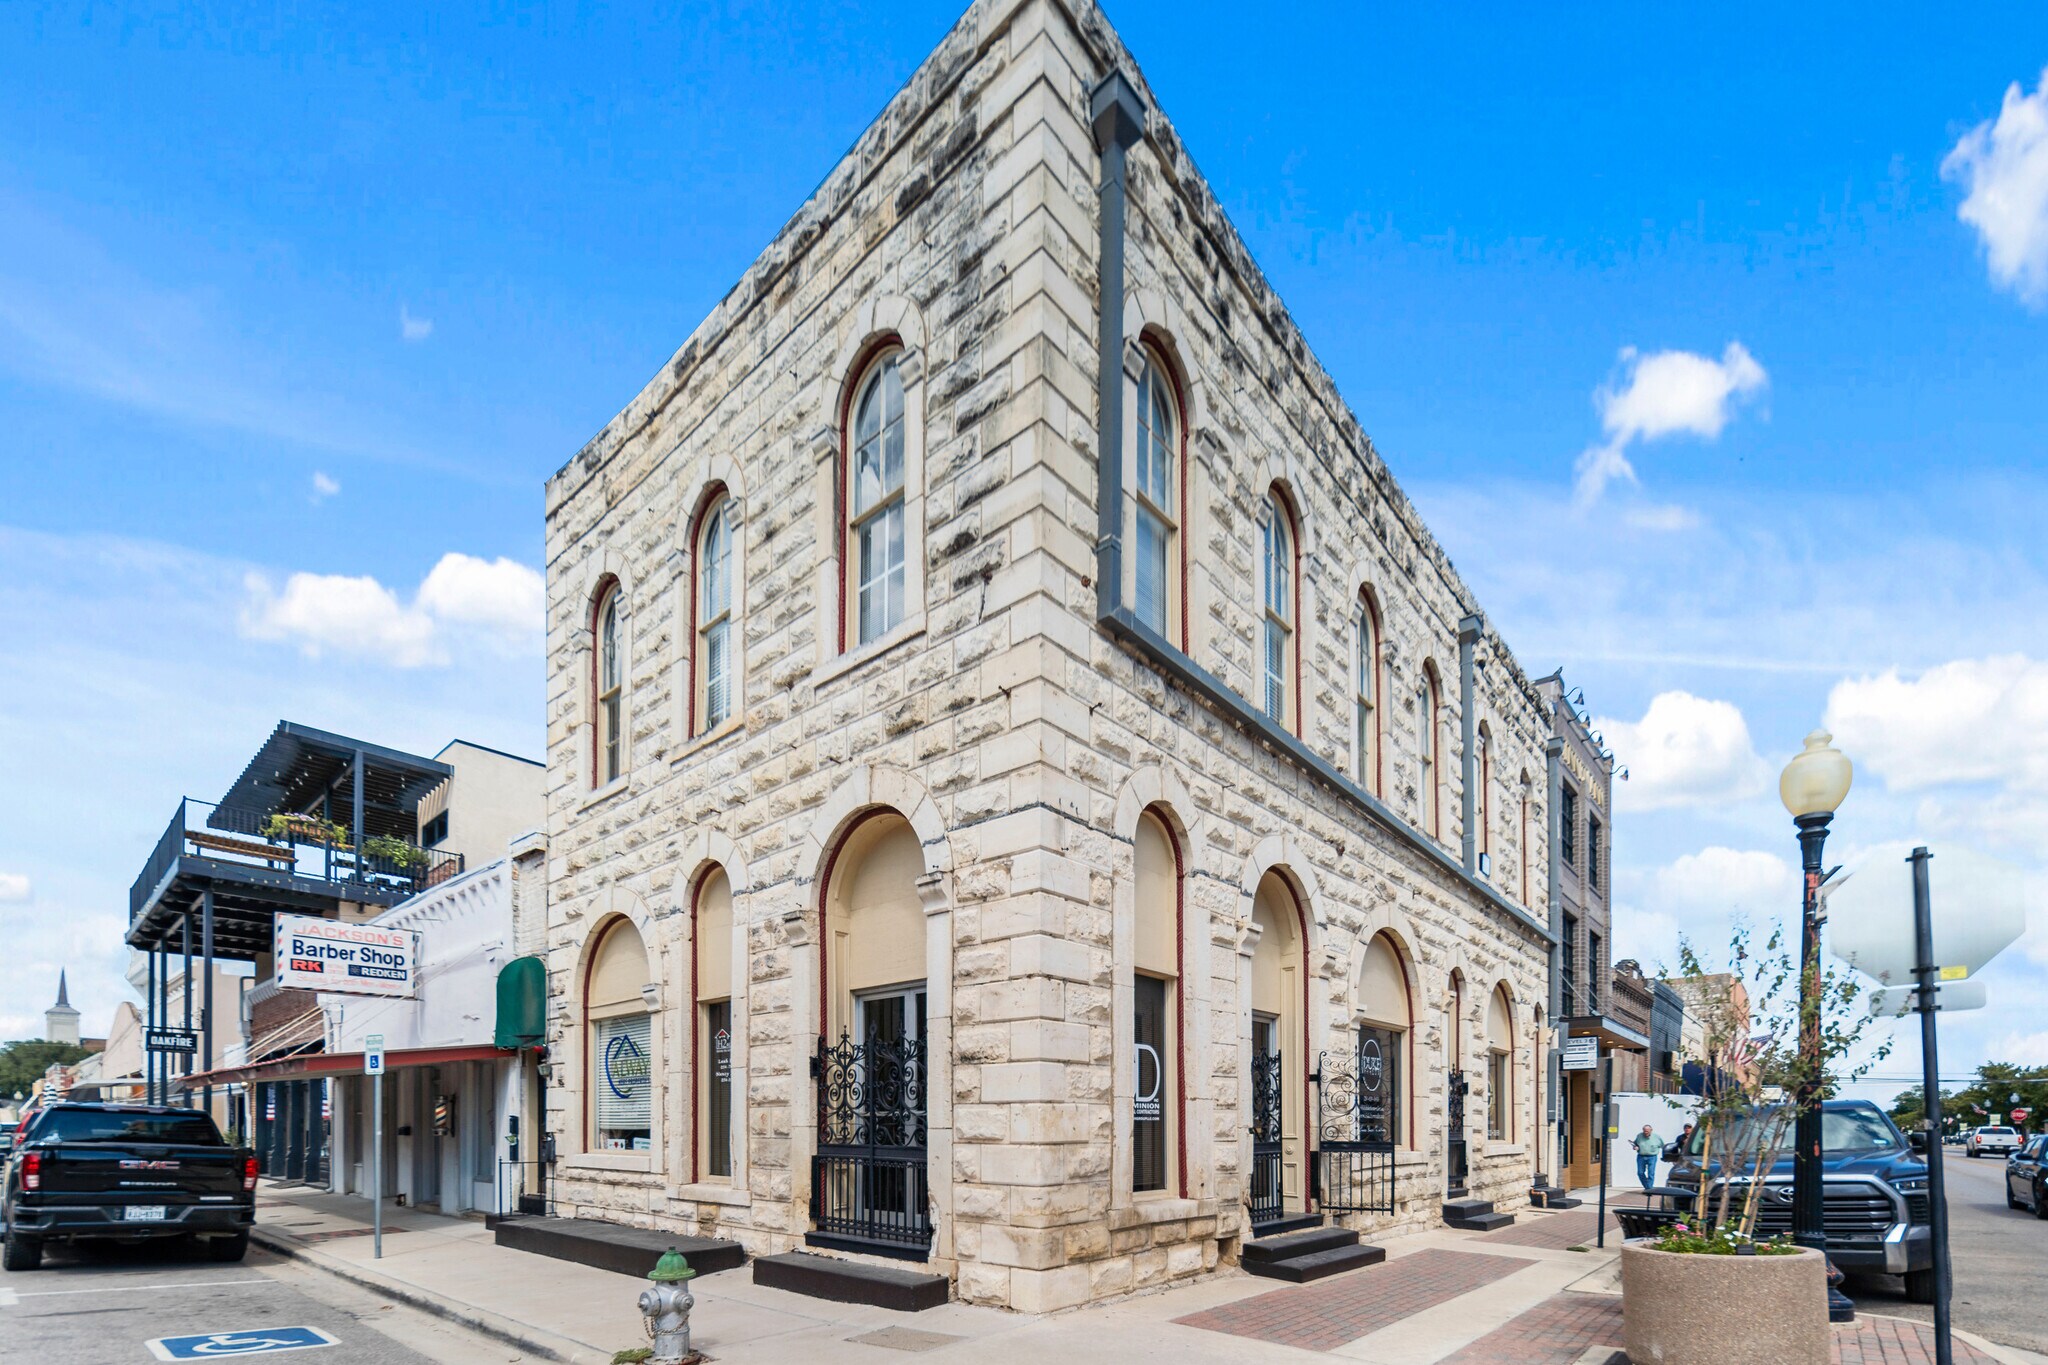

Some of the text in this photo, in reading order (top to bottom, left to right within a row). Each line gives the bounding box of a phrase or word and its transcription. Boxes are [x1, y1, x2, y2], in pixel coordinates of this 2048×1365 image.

[293, 925, 404, 947] JACKSON'S
[292, 939, 356, 961] Barber
[360, 946, 405, 969] Shop
[291, 959, 323, 973] RK
[361, 967, 406, 980] REDKEN
[150, 1034, 193, 1047] OAKFIRE
[119, 1160, 180, 1169] GMC
